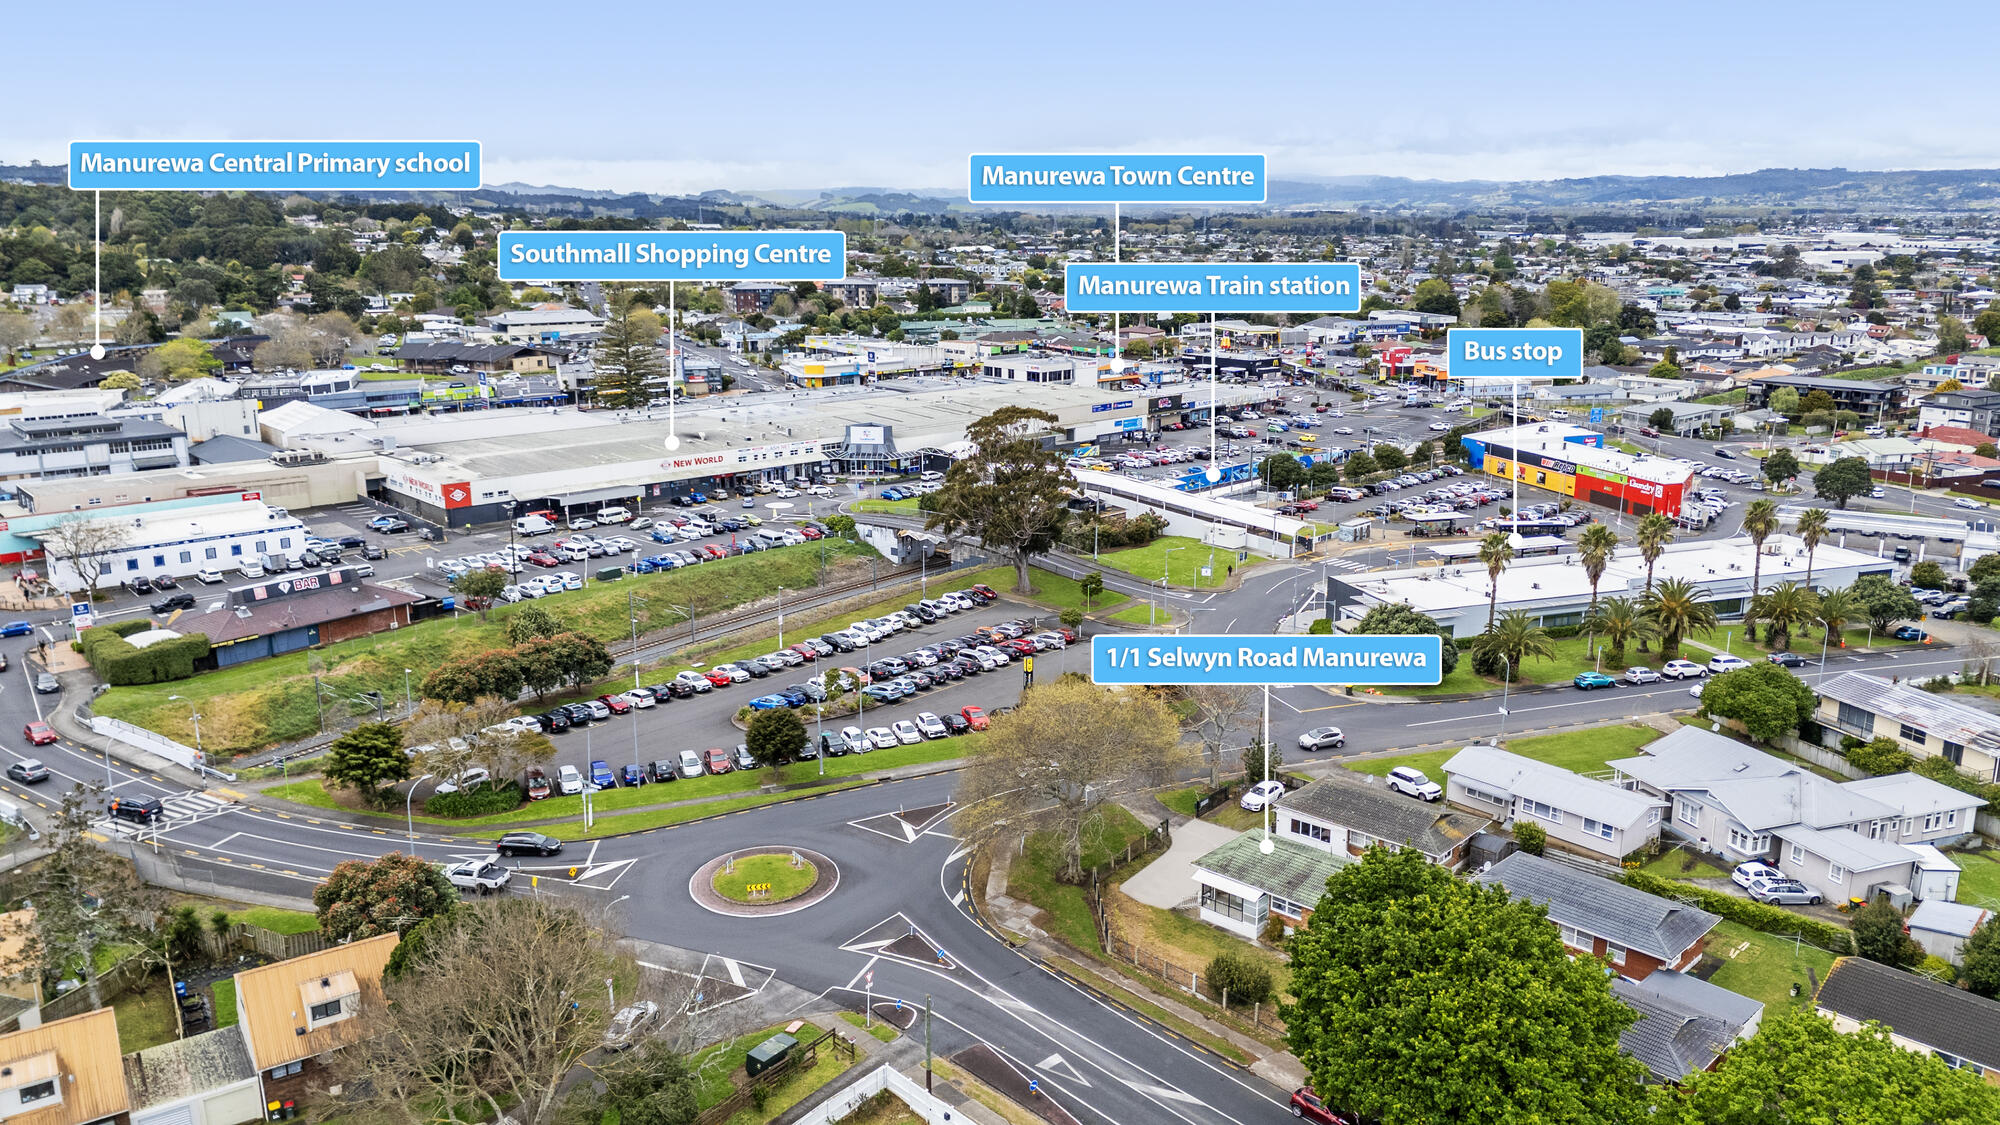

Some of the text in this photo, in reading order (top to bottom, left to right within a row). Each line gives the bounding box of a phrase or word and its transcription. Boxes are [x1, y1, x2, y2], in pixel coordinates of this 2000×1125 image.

[673, 455, 724, 468] NEW WORLD
[408, 476, 418, 486] NEW
[417, 479, 433, 492] WORLD
[293, 577, 320, 591] BAR
